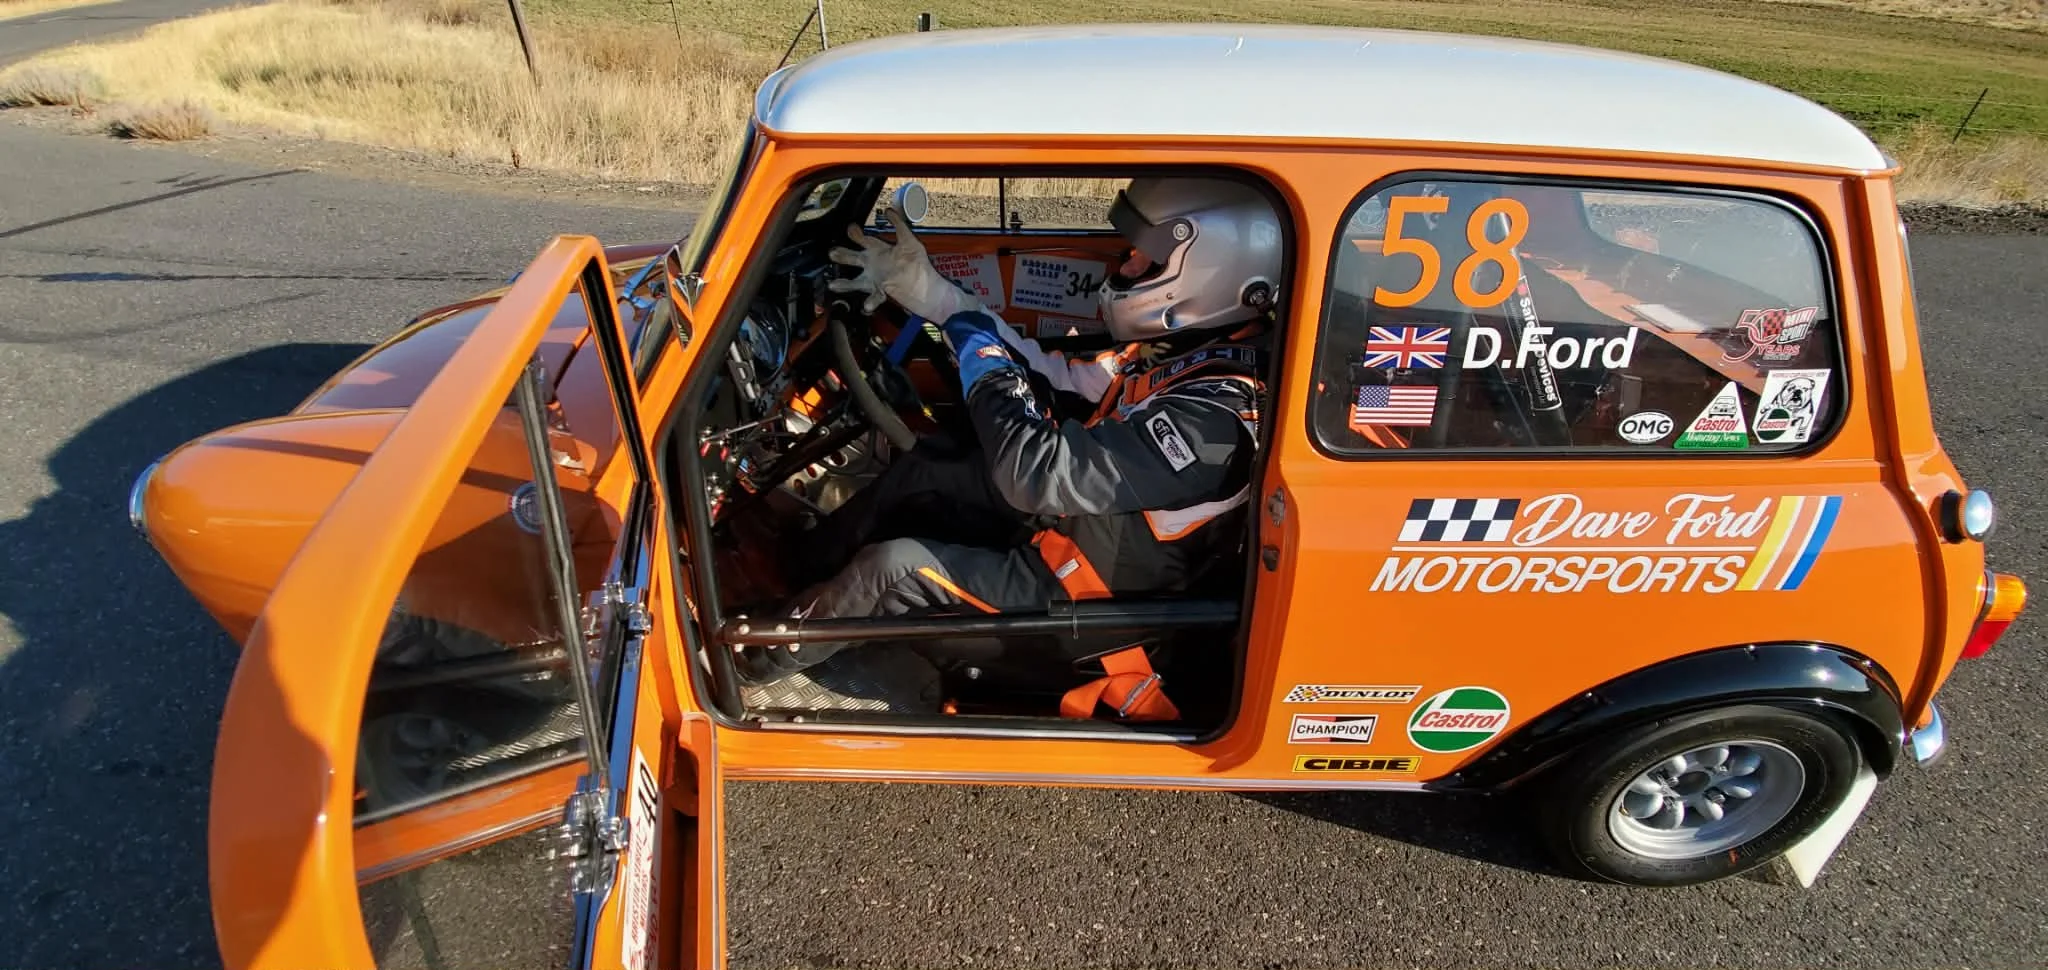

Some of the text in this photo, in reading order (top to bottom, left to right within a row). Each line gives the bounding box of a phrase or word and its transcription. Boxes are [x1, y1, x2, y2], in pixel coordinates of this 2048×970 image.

[1374, 196, 1529, 308] 58
[1066, 272, 1092, 298] 34
[1780, 324, 1808, 342] SPORT
[1462, 326, 1639, 369] D.Ford
[1758, 344, 1801, 356] YEARS
[1622, 419, 1671, 435] OMG
[1694, 417, 1740, 431] Castrol
[1759, 420, 1789, 430] Castrol
[1513, 493, 1772, 546] Dave Ford
[1369, 555, 1746, 594] MOTORSPORTS
[1320, 690, 1415, 699] DUNLOP
[1418, 711, 1505, 729] Castrol
[1296, 723, 1370, 736] CHAMPION
